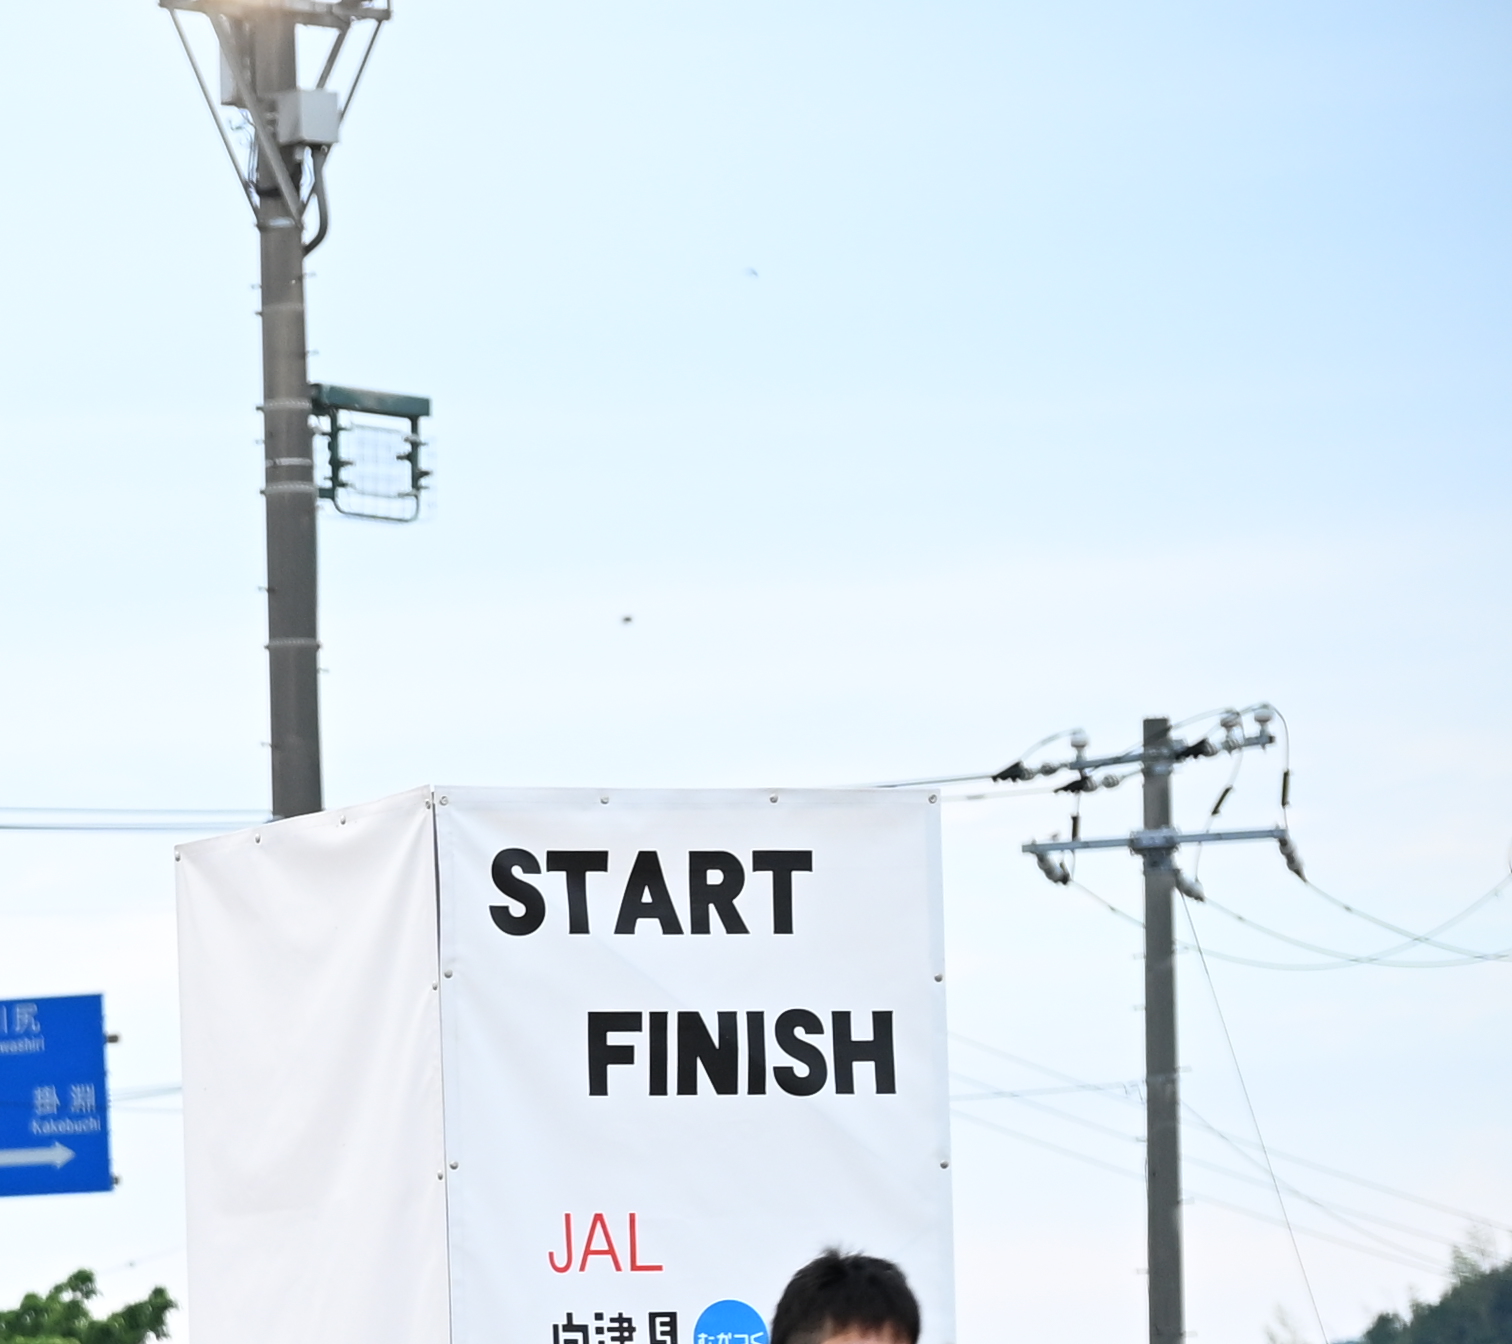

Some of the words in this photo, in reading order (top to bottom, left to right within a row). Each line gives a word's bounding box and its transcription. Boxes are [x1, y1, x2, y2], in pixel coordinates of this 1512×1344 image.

[490, 848, 812, 936] START
[587, 1009, 897, 1097] FINISH
[548, 1212, 664, 1274] JAL
